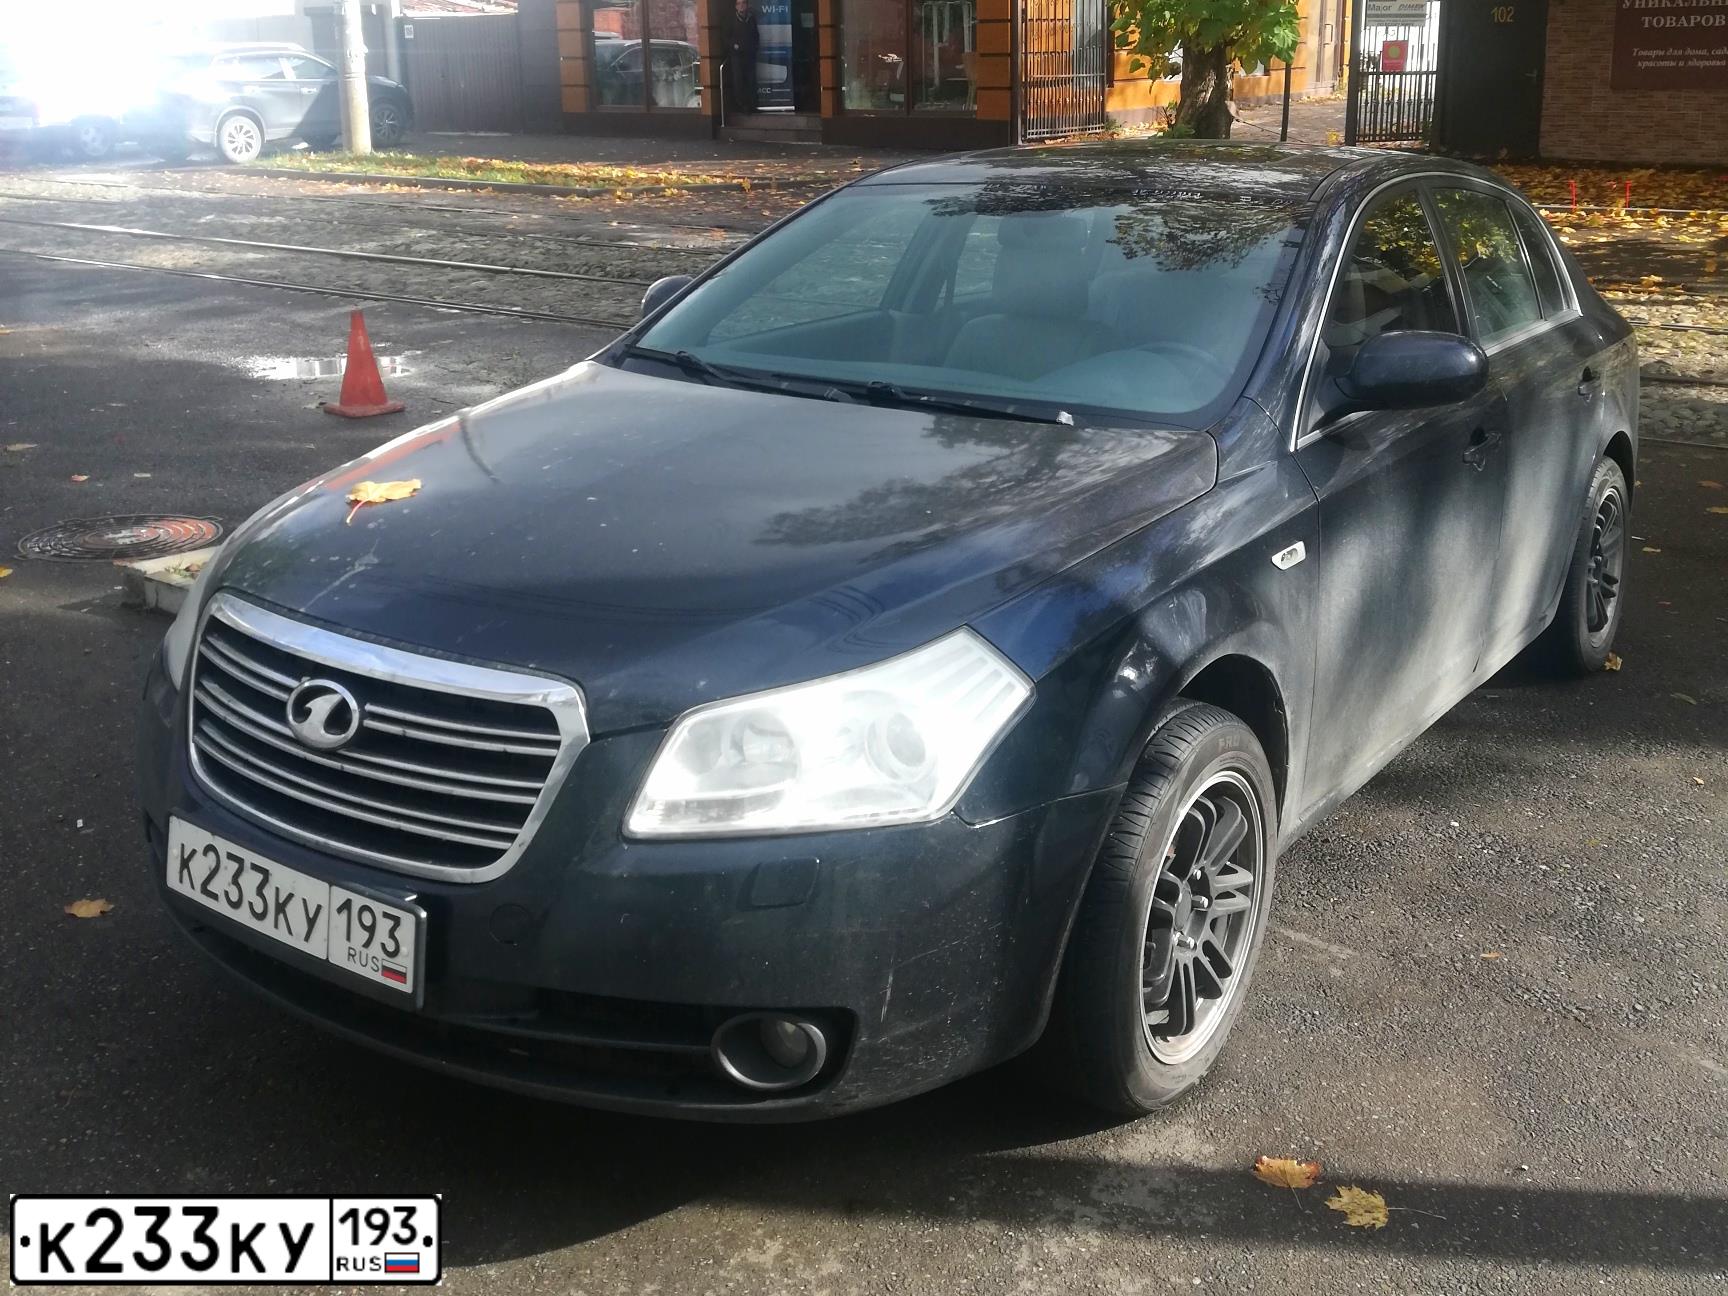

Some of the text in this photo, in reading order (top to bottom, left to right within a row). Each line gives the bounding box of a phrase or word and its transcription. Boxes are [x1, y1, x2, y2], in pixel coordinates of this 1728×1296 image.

[762, 5, 788, 13] WI-FI
[1623, 0, 1728, 9] УНИКАЛЬН
[1490, 6, 1514, 23] 102
[1641, 14, 1726, 28] ТОВАРОВ
[1632, 48, 1666, 58] Товары
[1666, 47, 1683, 56] для
[336, 898, 401, 958] 193
[347, 946, 380, 973] RUS
